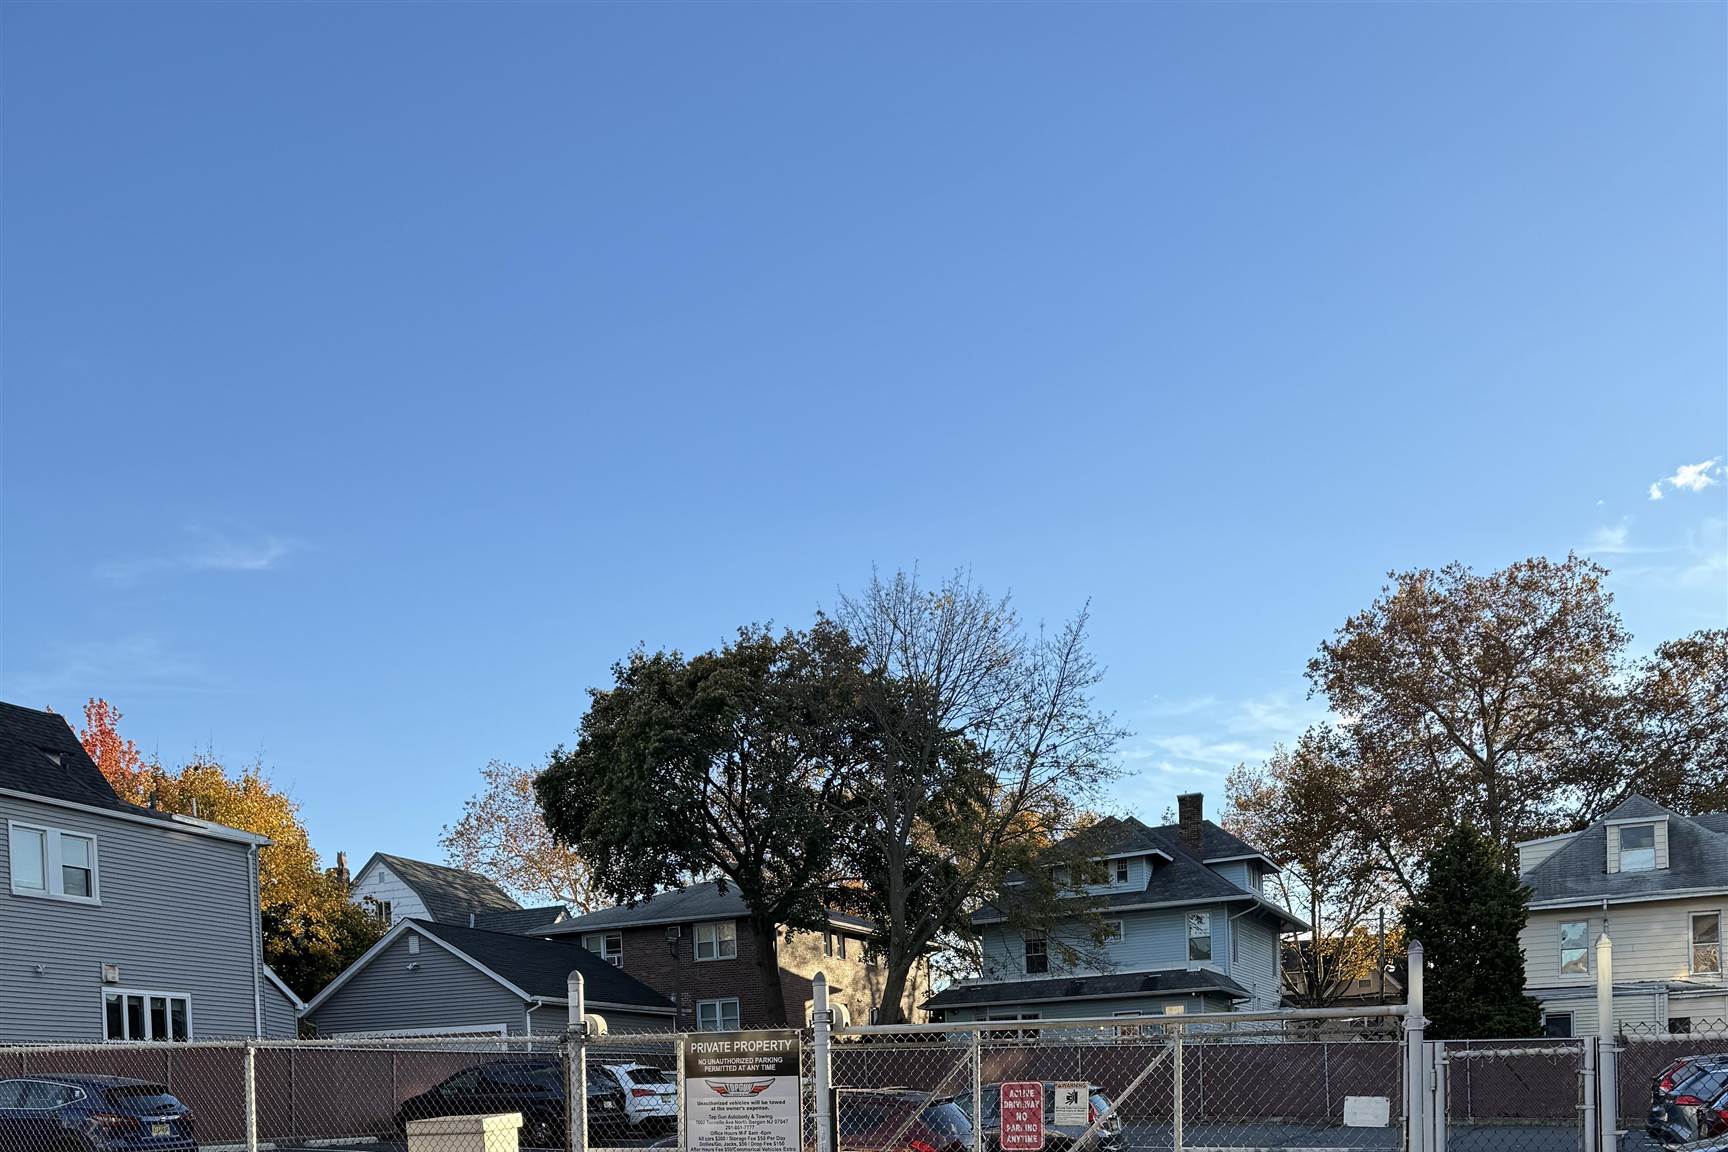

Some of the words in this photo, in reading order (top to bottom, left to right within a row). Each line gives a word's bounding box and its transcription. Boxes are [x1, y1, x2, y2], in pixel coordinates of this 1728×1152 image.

[691, 1042, 730, 1054] PRIVATE
[734, 1040, 791, 1052] PROPERTY
[1009, 1089, 1034, 1098] ACTIVE
[1016, 1112, 1028, 1120] NO
